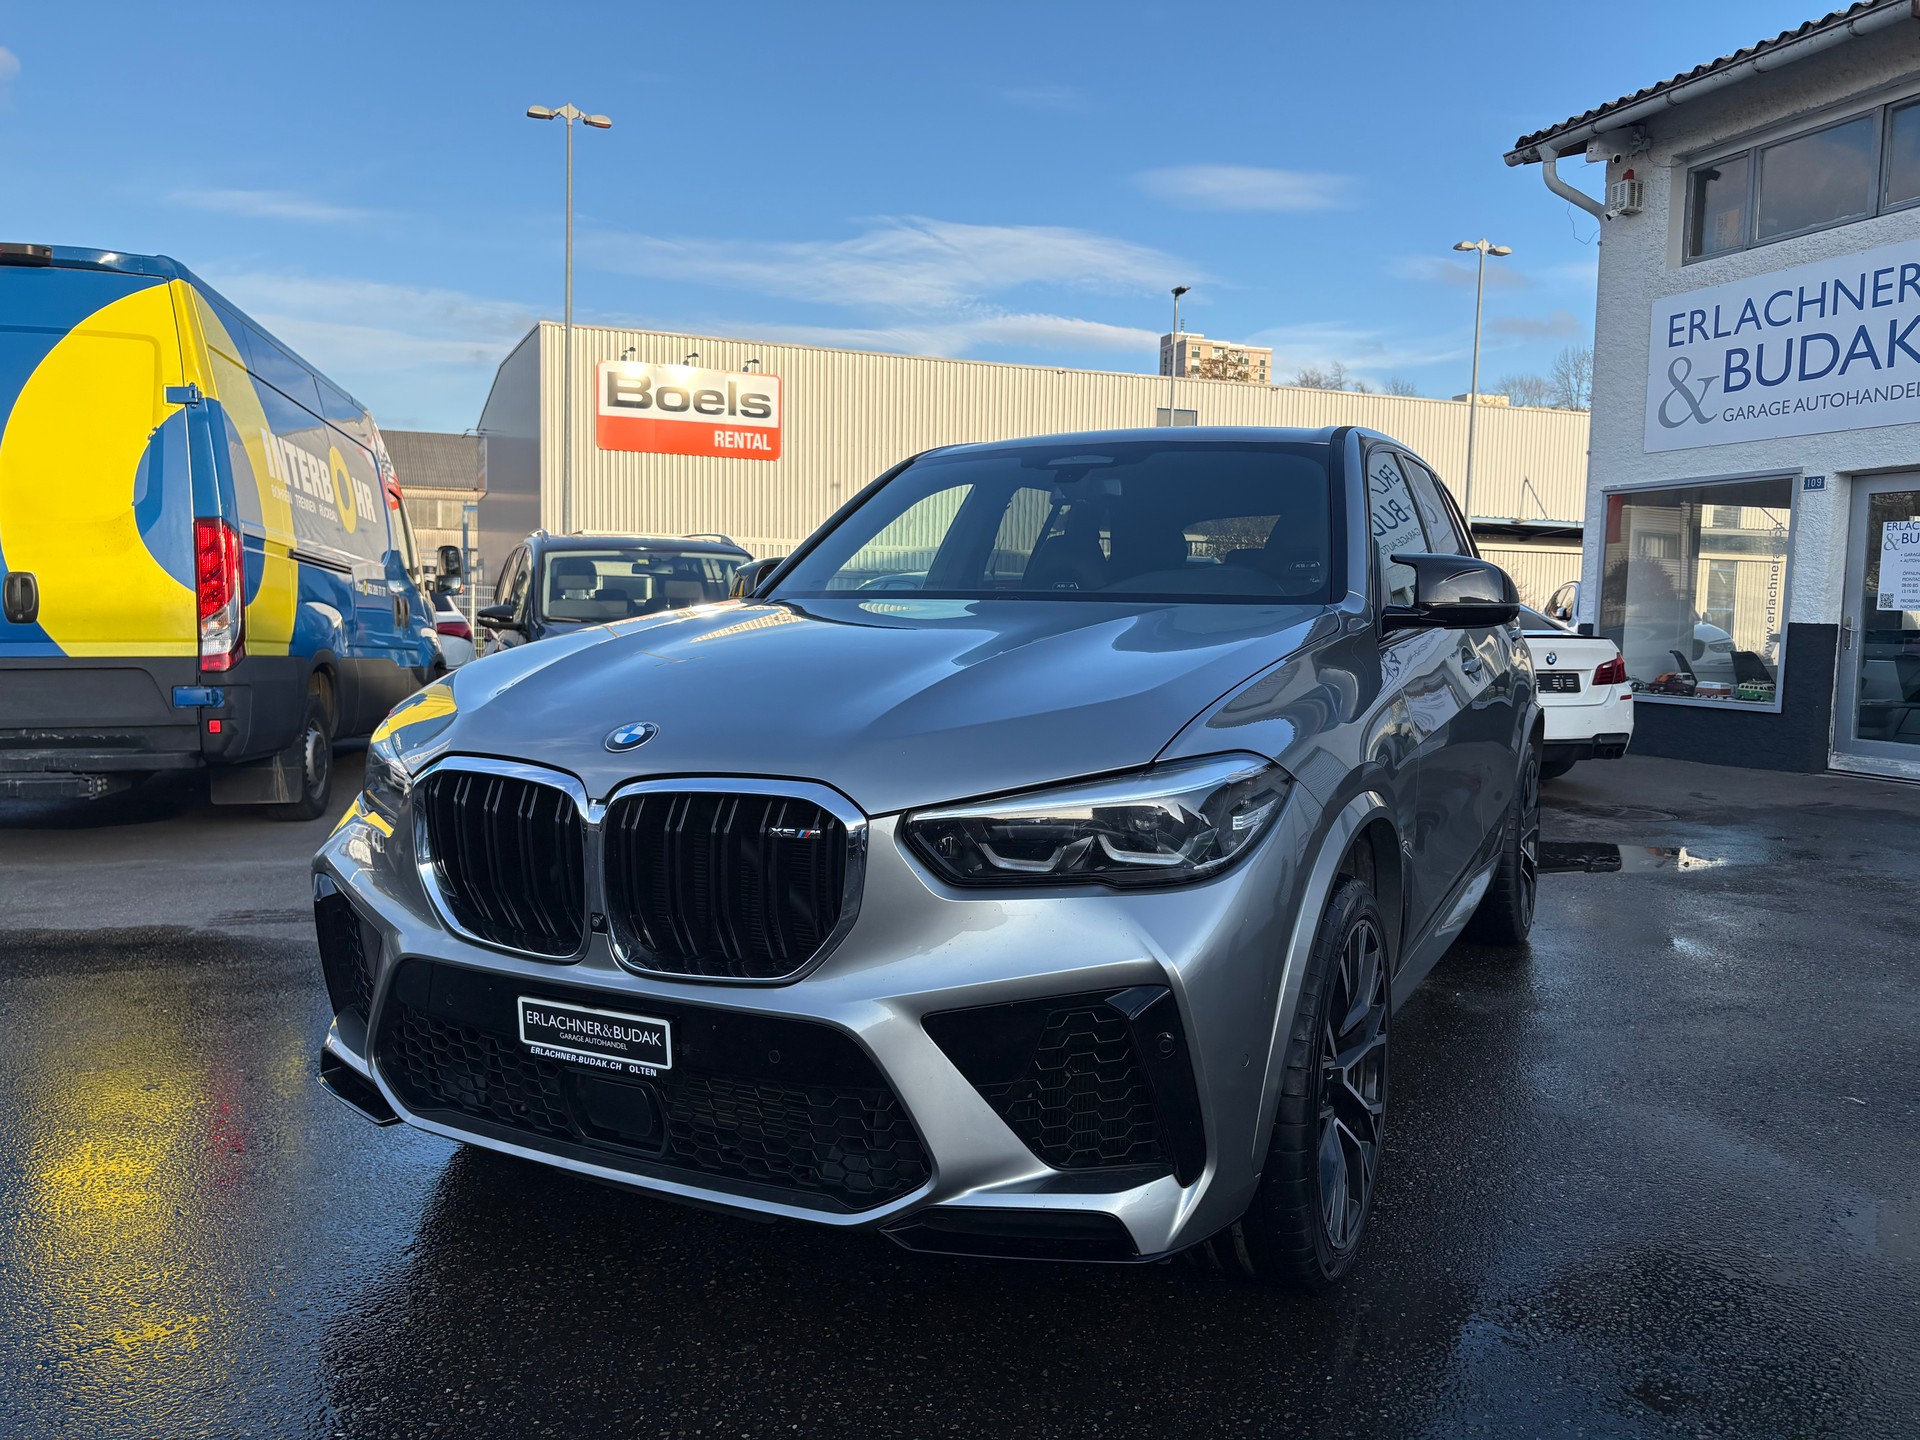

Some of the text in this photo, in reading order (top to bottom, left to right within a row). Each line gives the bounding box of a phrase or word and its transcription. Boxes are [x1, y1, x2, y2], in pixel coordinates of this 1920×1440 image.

[1668, 262, 1920, 347] ERLACHNER
[1658, 314, 1920, 429] & BUDAK
[607, 371, 772, 419] Boels
[1722, 399, 1790, 422] GARAGE
[713, 430, 772, 451] RENTAL
[1807, 478, 1822, 488] 109
[1883, 533, 1900, 551] &
[526, 1010, 662, 1047] ERLACHNER&BUDAK
[559, 1032, 628, 1051] GARAGE AUTOHANDEL
[530, 1046, 657, 1077] ERLACHNER-BUDAK.CH OLTEN
